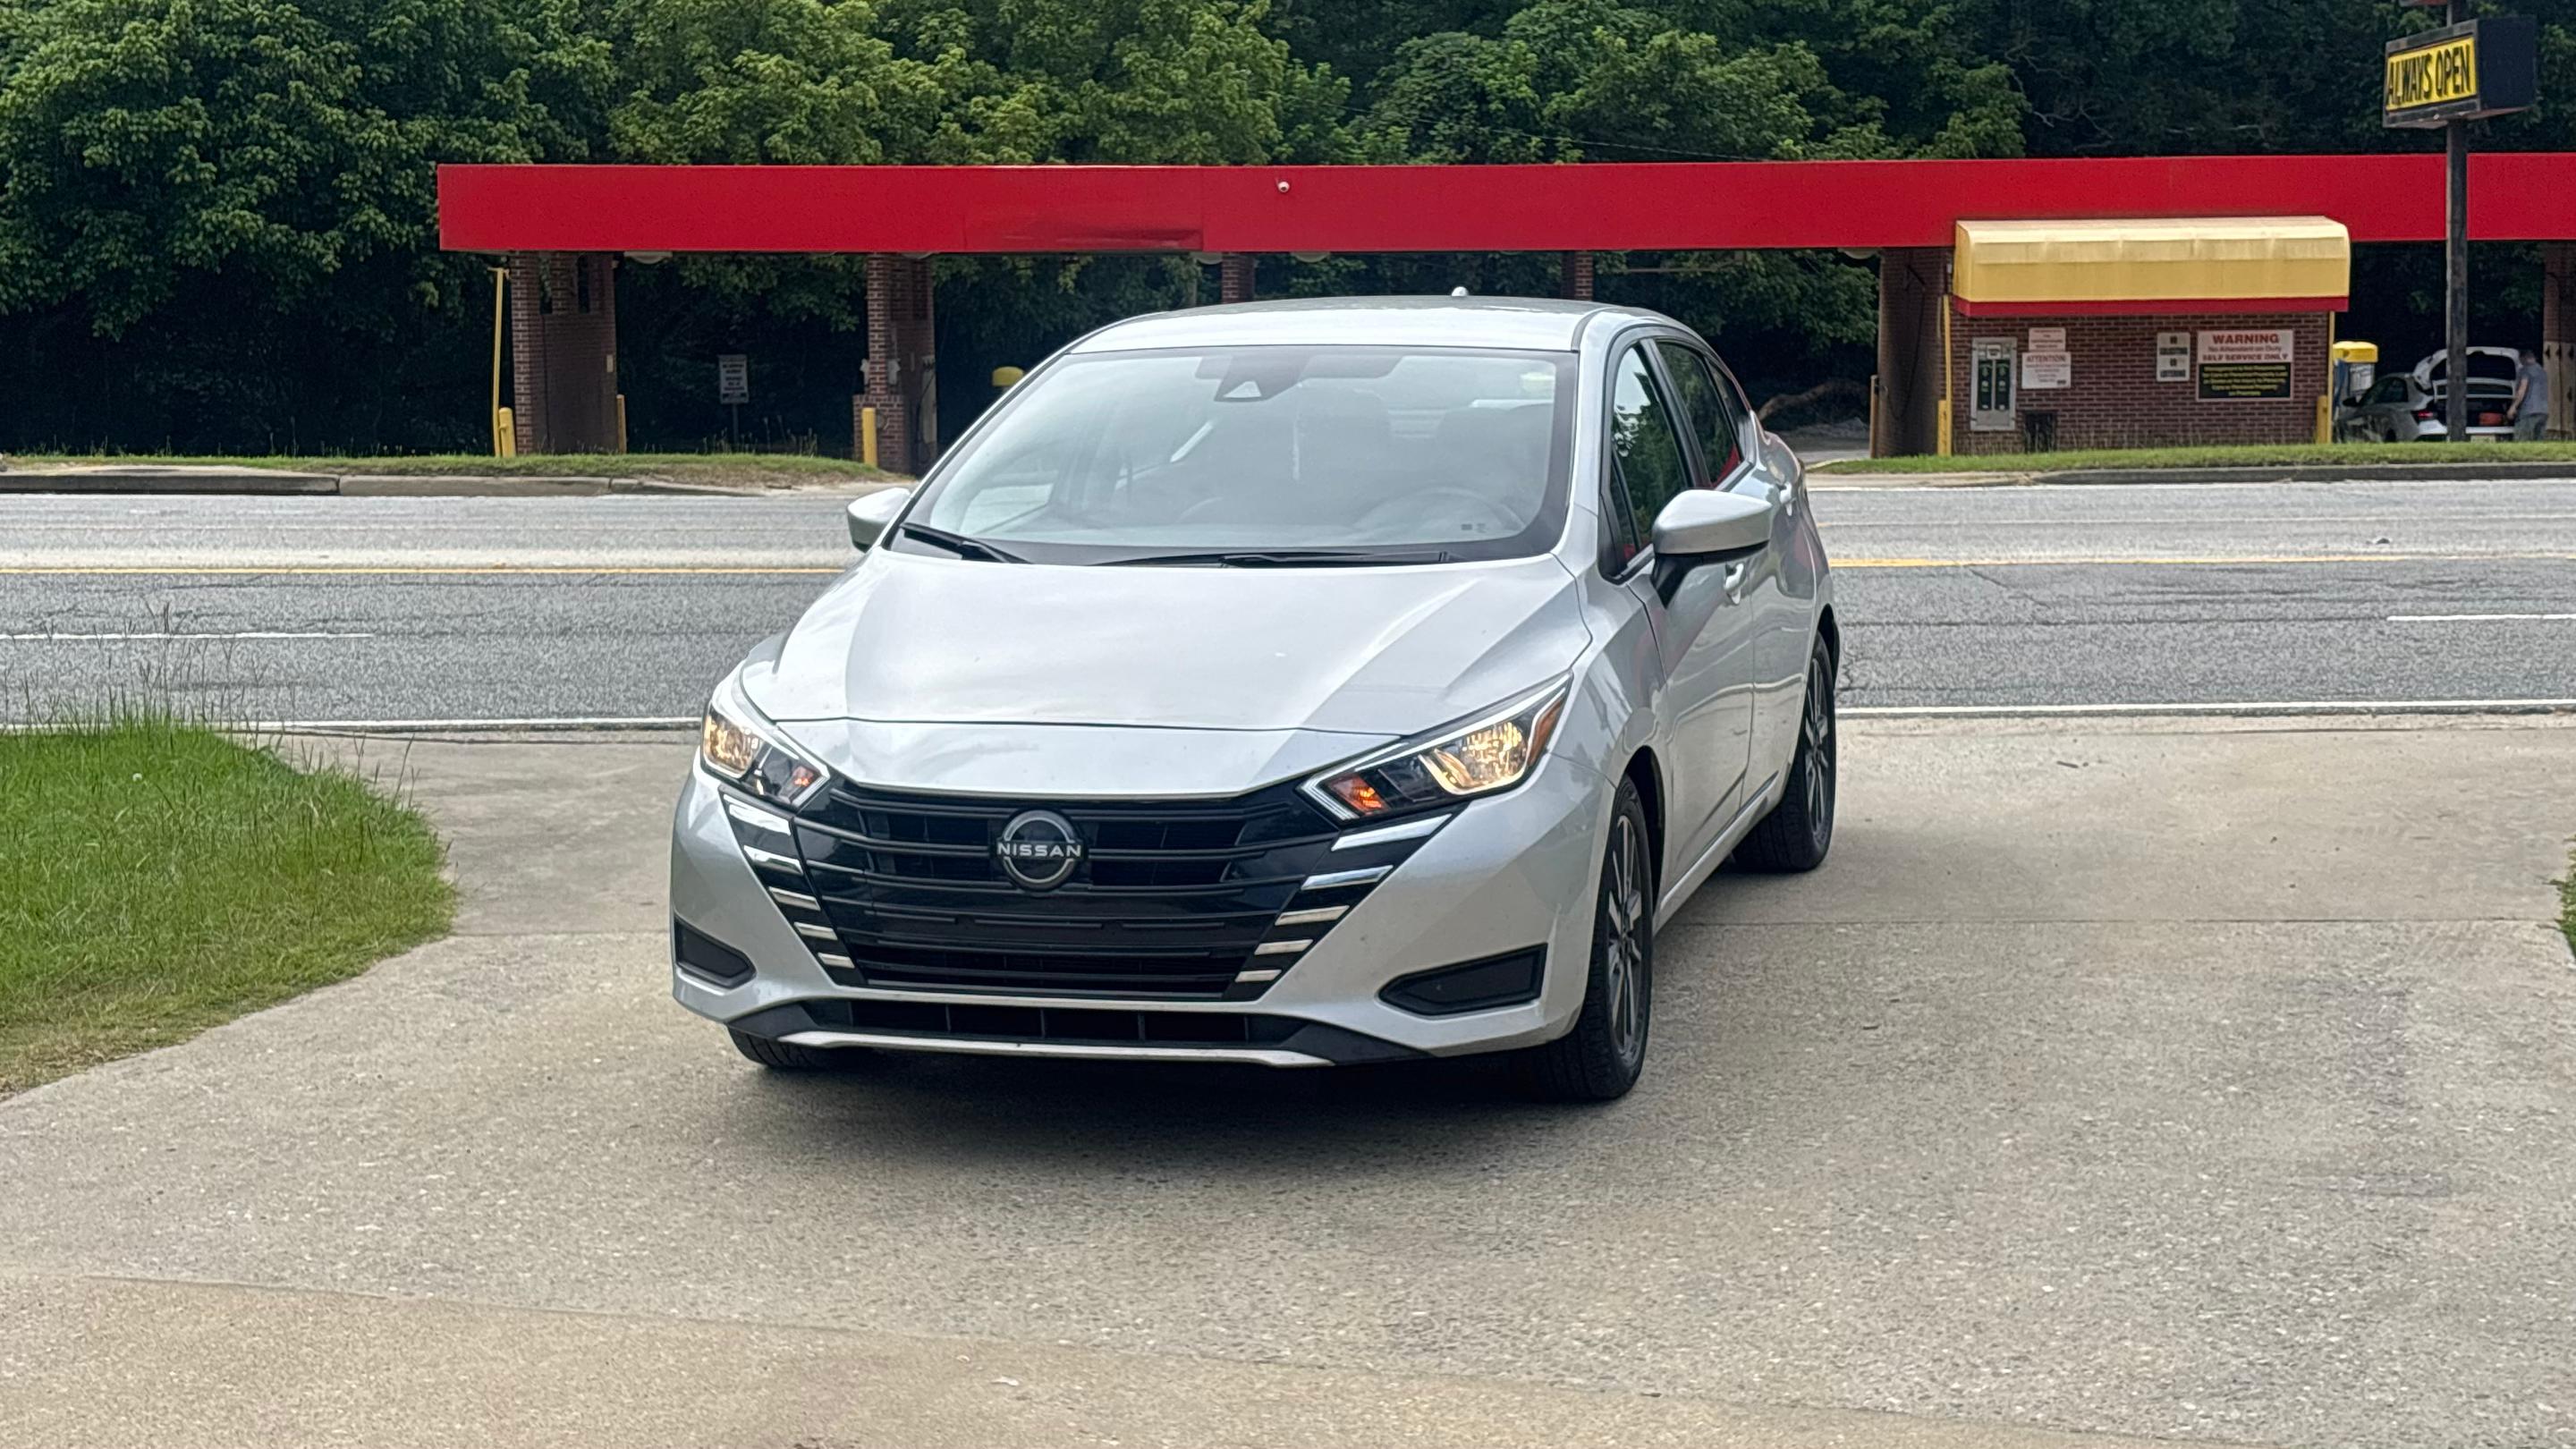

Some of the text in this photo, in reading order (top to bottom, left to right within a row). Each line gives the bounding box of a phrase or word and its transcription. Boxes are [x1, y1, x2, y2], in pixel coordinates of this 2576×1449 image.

[2386, 44, 2471, 106] ALWAYS OPEN
[2212, 334, 2279, 343] WARNING
[997, 843, 1081, 857] NISSAN
